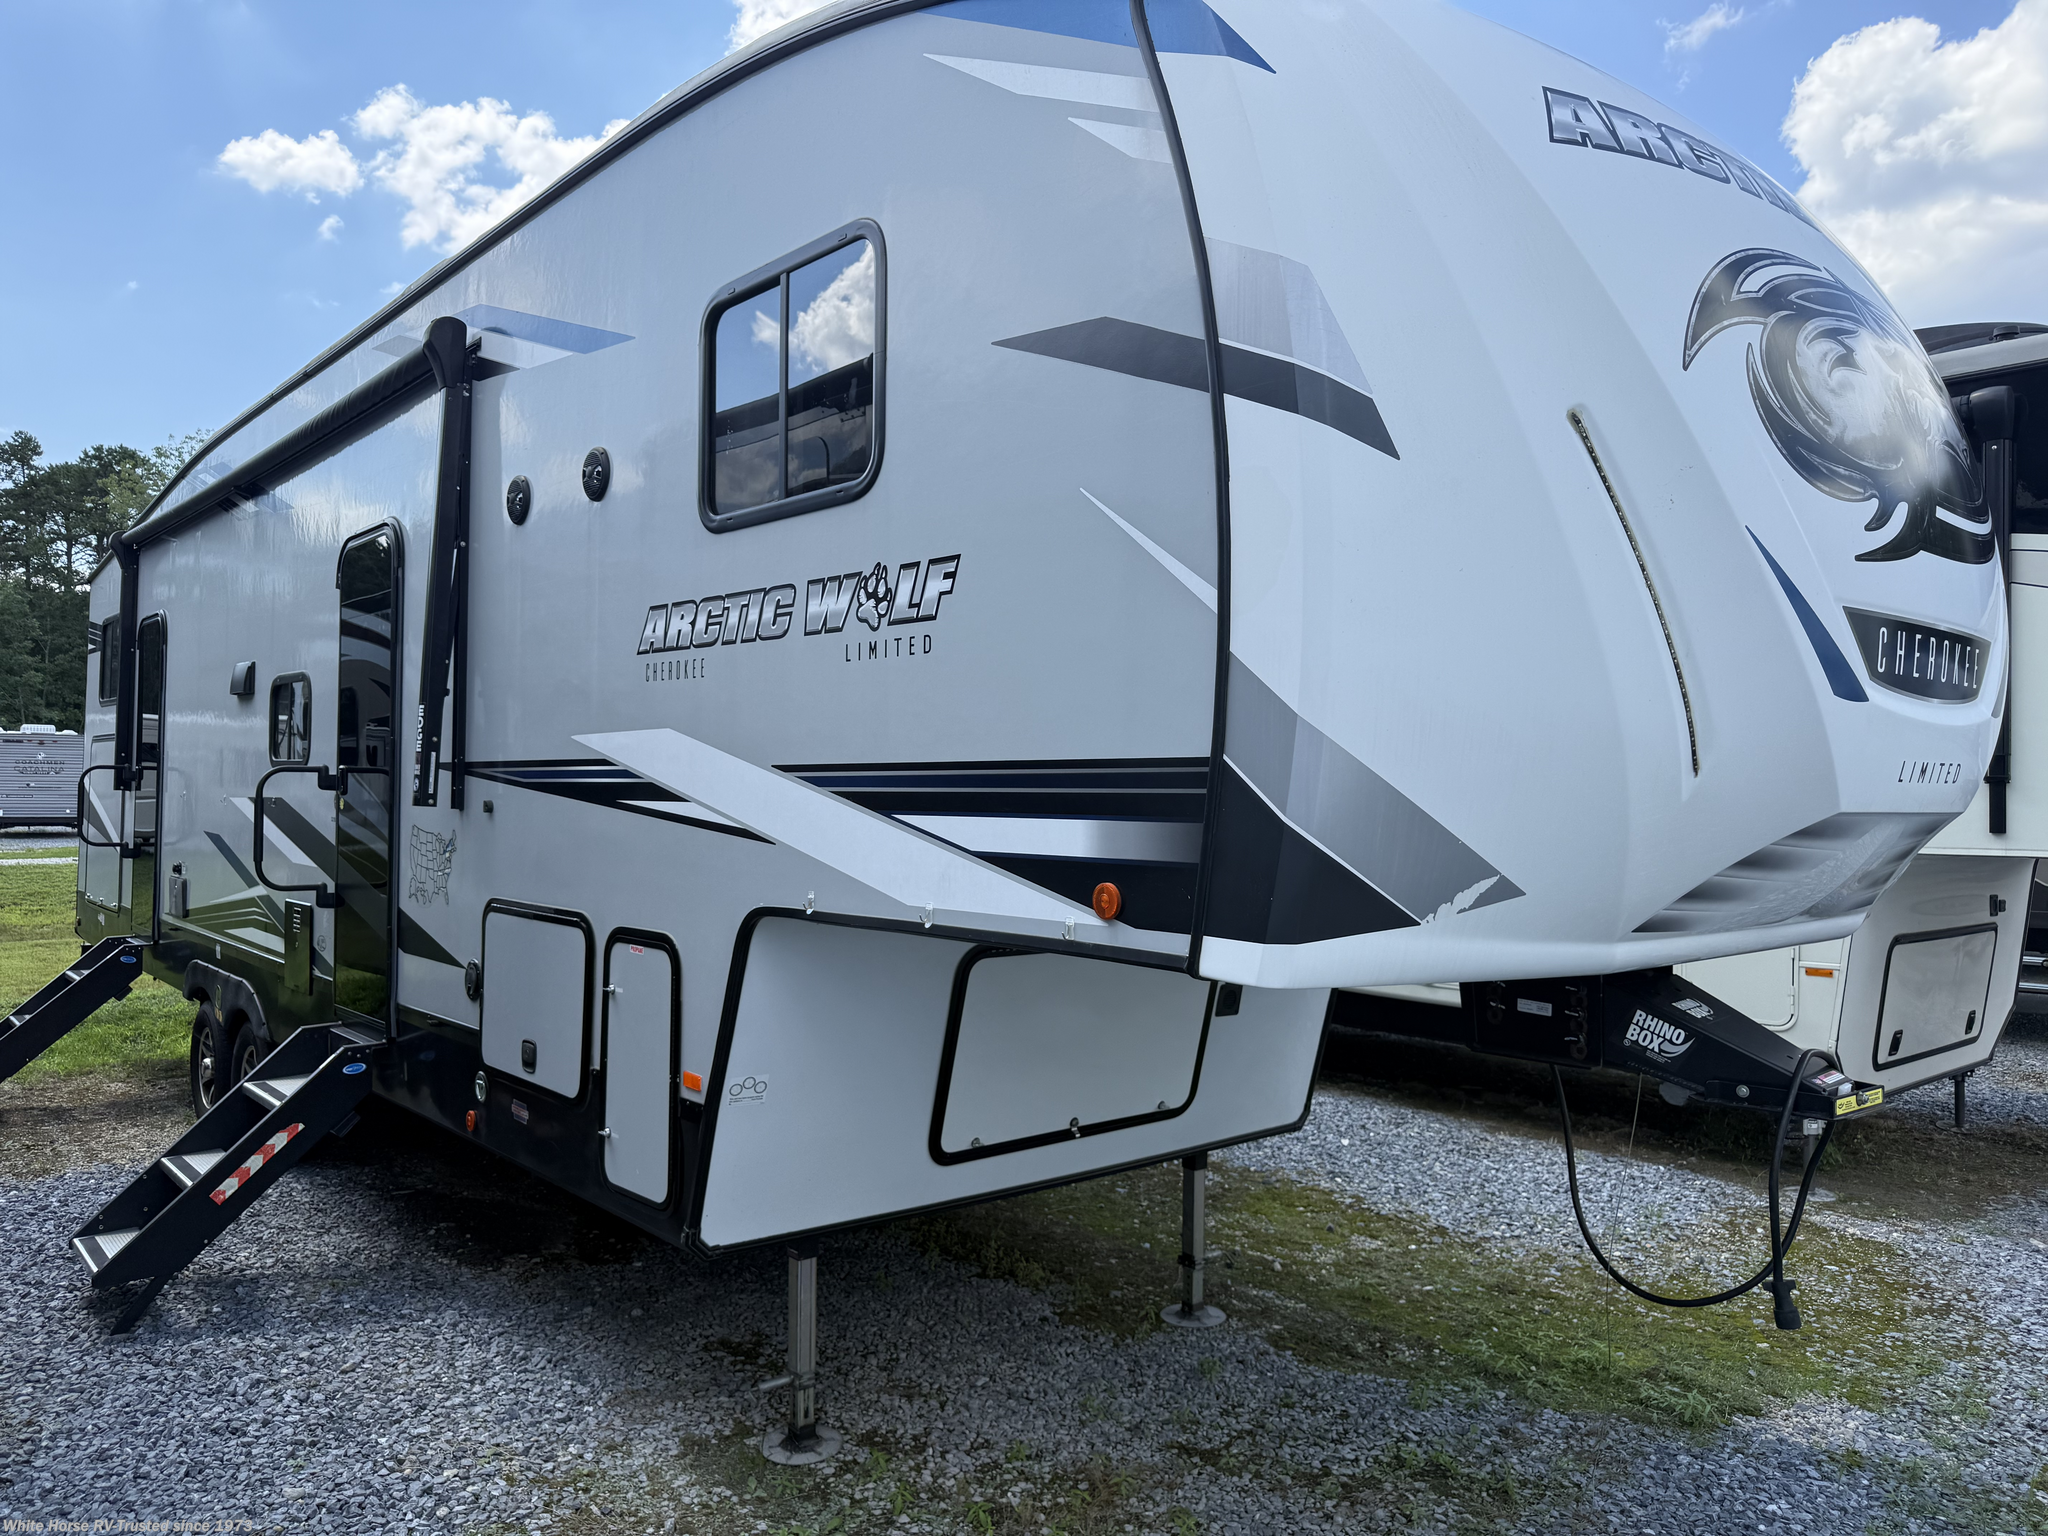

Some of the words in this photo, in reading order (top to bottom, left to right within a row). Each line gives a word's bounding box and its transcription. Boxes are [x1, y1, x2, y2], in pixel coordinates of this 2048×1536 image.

[637, 583, 797, 655] ARCTIC
[844, 634, 933, 663] LIMITED
[1877, 627, 1981, 689] CHEROKEE
[645, 658, 706, 682] CHEROKEE
[1898, 761, 1962, 784] LIMITED
[1625, 1023, 1666, 1054] BOX
[1631, 1008, 1686, 1045] RHINO
